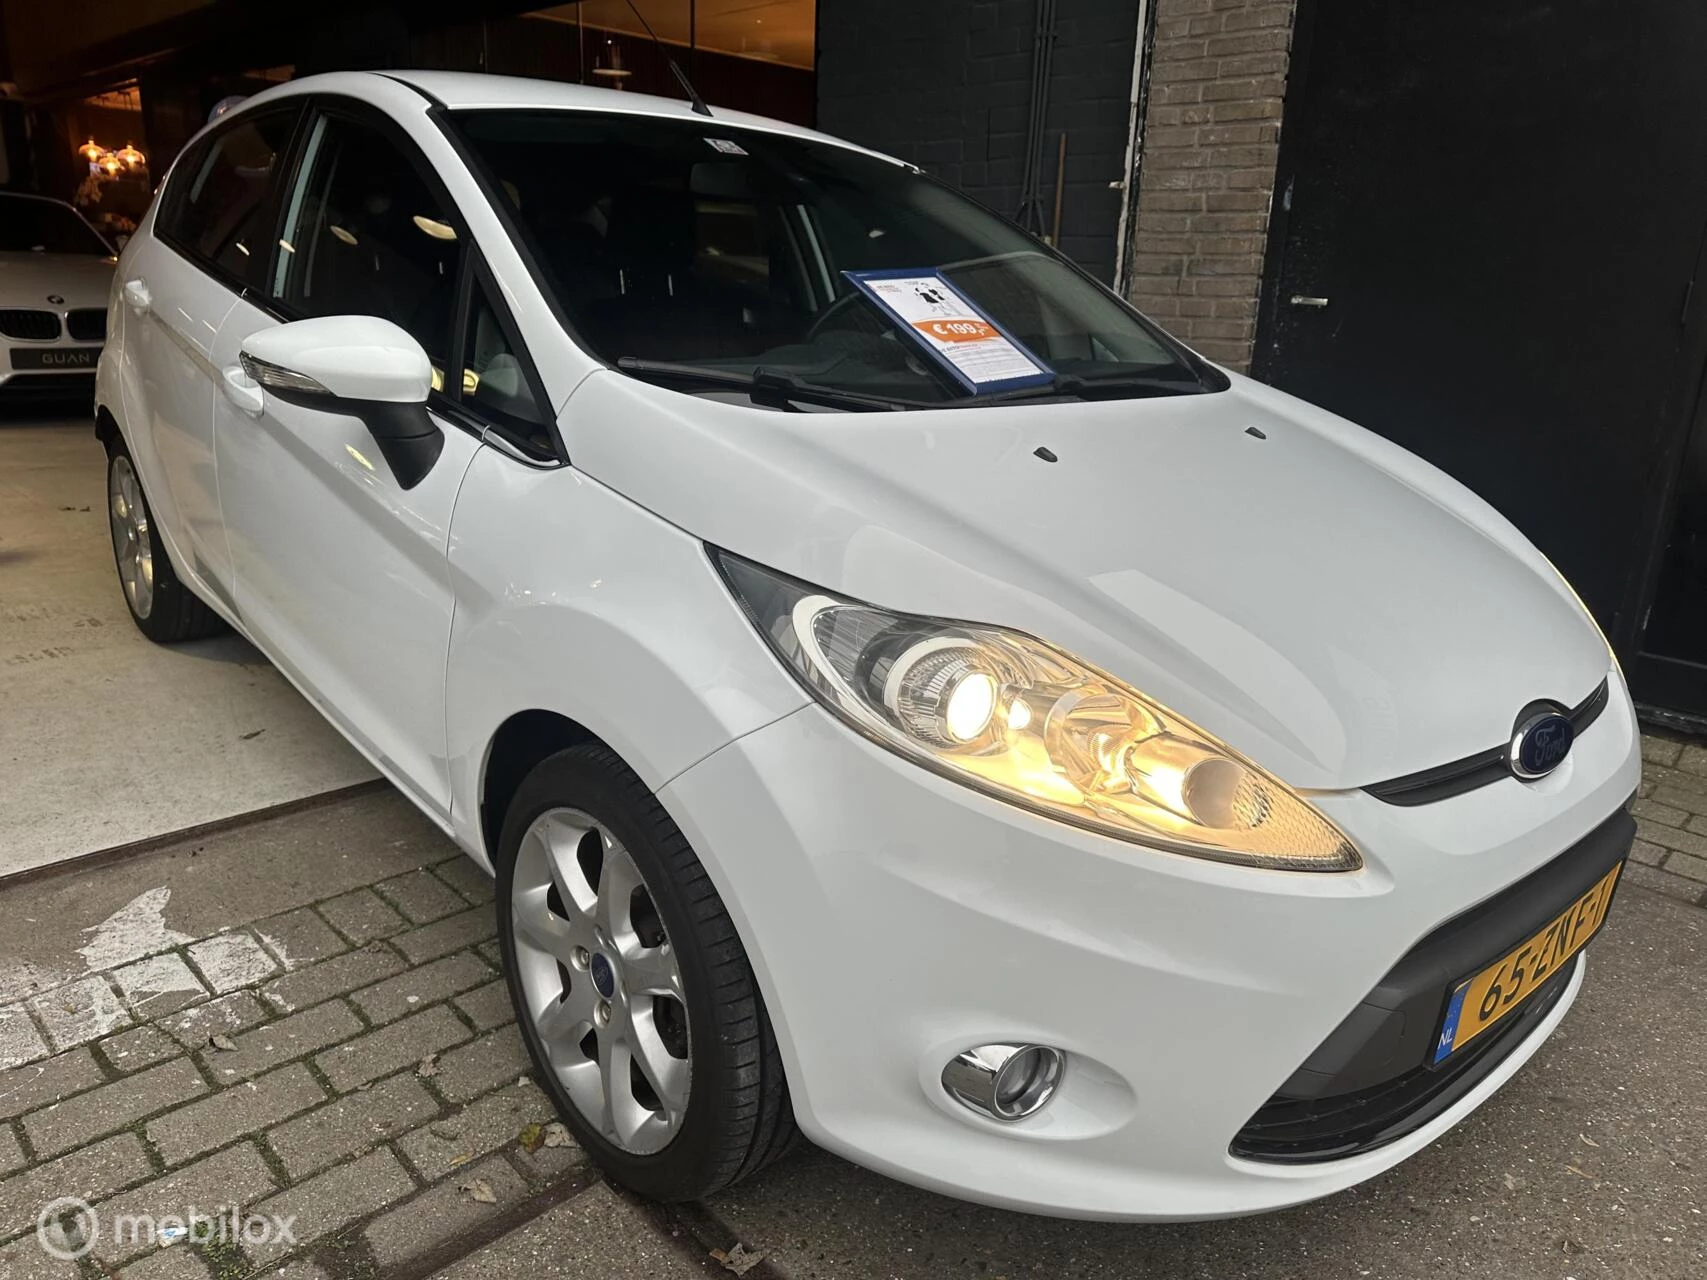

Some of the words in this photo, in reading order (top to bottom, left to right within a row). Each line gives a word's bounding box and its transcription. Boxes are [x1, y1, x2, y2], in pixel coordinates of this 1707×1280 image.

[932, 323, 949, 335] €
[42, 353, 90, 365] GUAN
[1534, 724, 1567, 767] Ford
[1478, 875, 1609, 1022] 65-ZNF-1
[1437, 1027, 1453, 1050] NL
